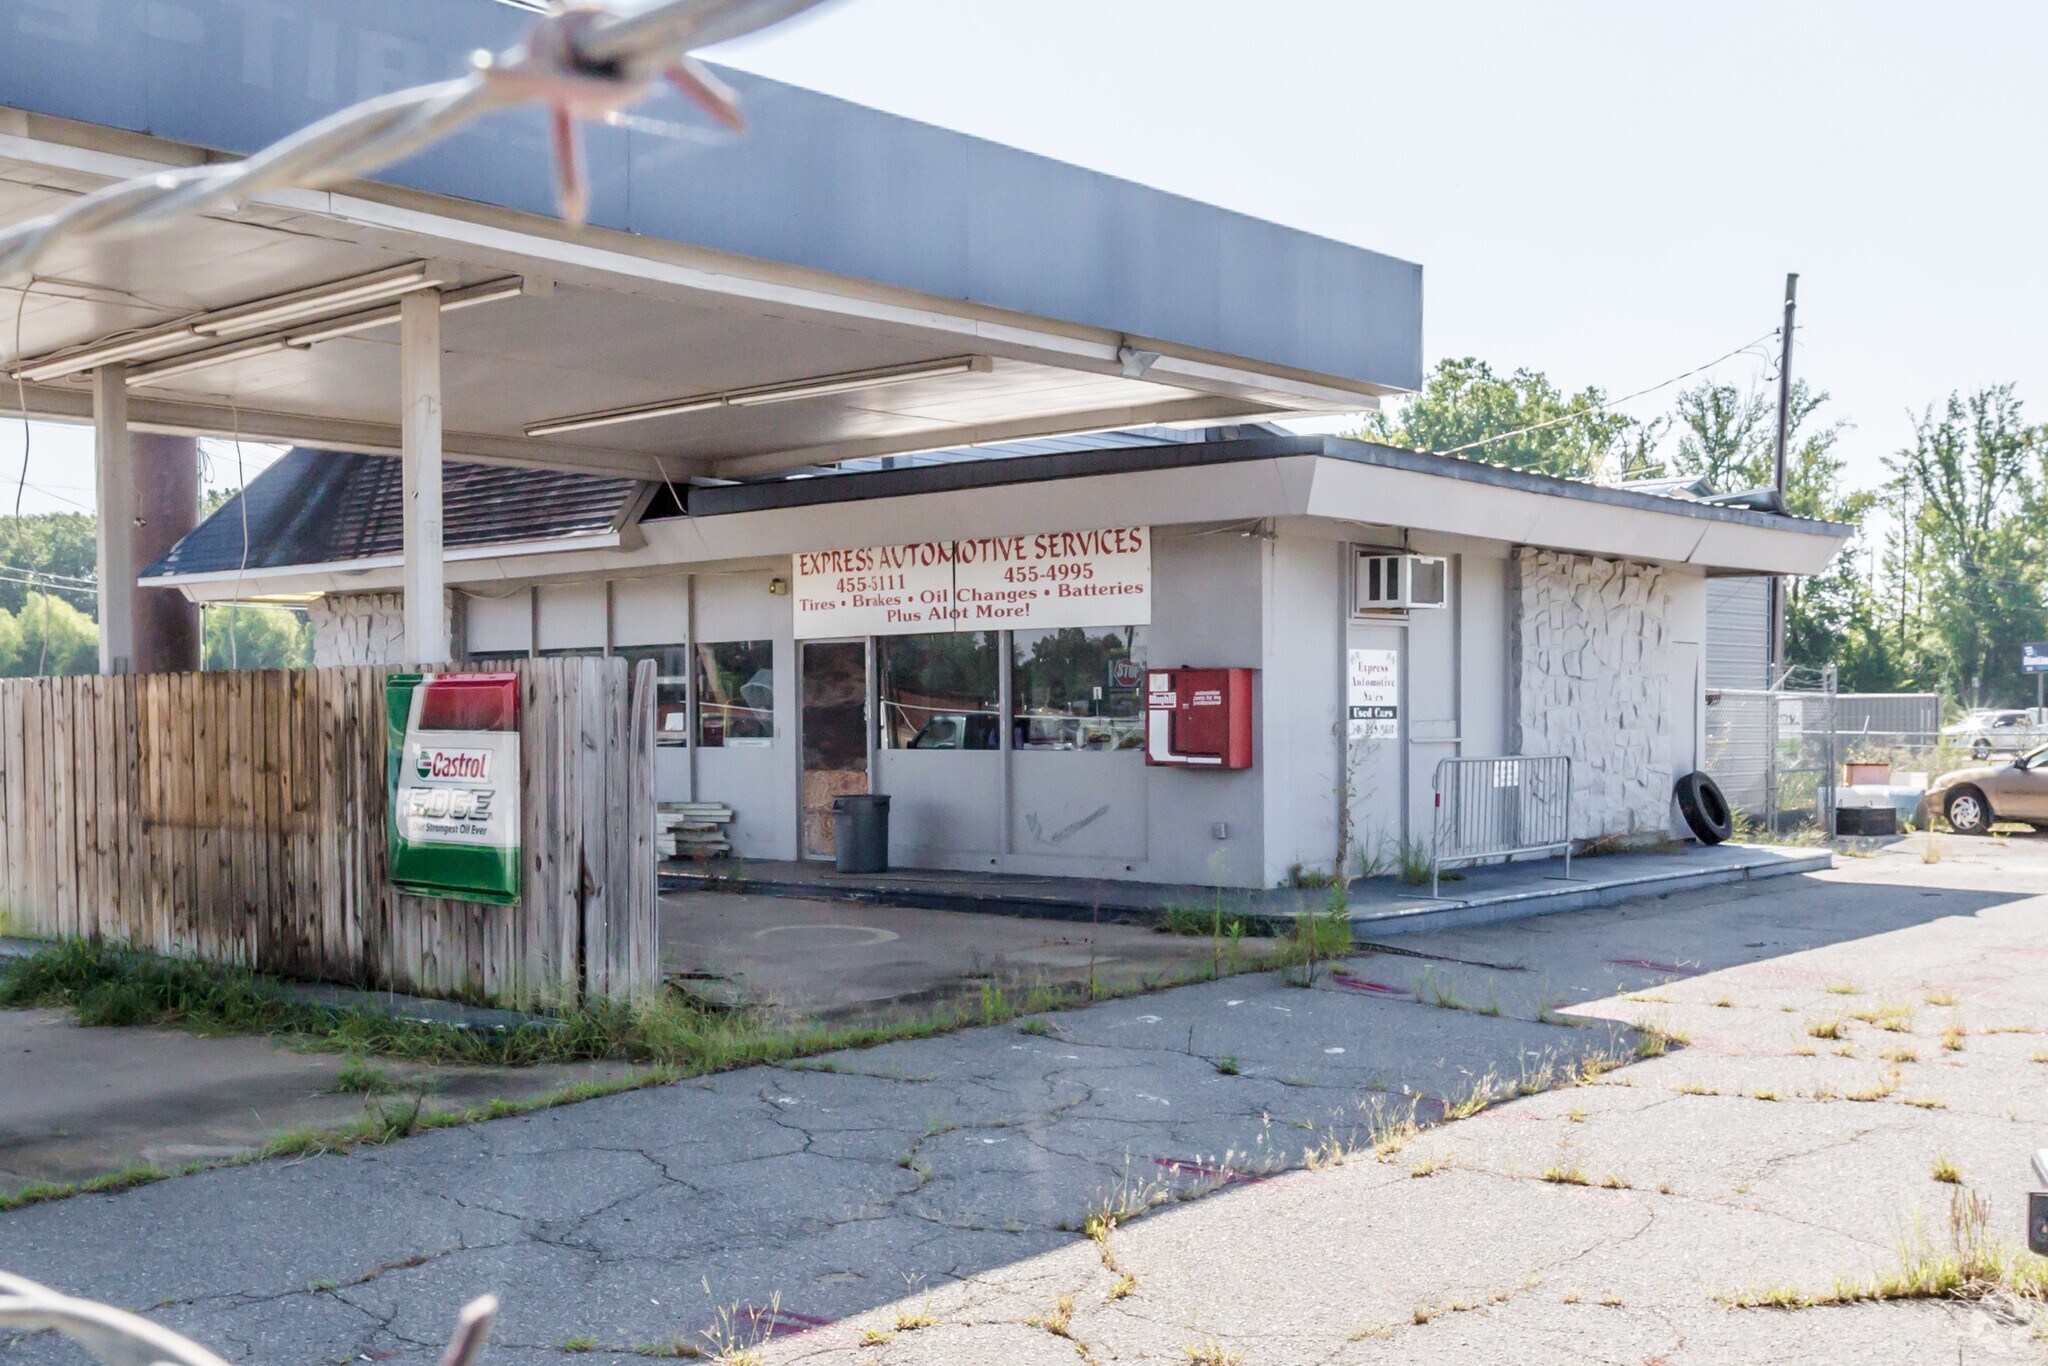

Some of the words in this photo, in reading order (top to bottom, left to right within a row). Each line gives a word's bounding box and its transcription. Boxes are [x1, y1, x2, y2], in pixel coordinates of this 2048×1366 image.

[799, 548, 874, 576] EXPRESS
[879, 535, 1026, 570] AUTOMOTIVE
[1034, 526, 1143, 560] SERVICES
[836, 573, 906, 594] 455-5111
[1004, 562, 1094, 583] 455-4995
[799, 598, 836, 612] Tires
[852, 594, 901, 608] Brakes
[920, 588, 949, 604] Oil
[956, 585, 1037, 604] Changes
[1057, 581, 1144, 598] Batteries
[887, 608, 921, 623] Plus
[975, 604, 1031, 619] More!
[432, 751, 487, 779] Castrol
[410, 786, 495, 821] EDGE
[425, 822, 458, 836] Strongest
[460, 824, 470, 834] Oil
[471, 825, 488, 835] Ever
